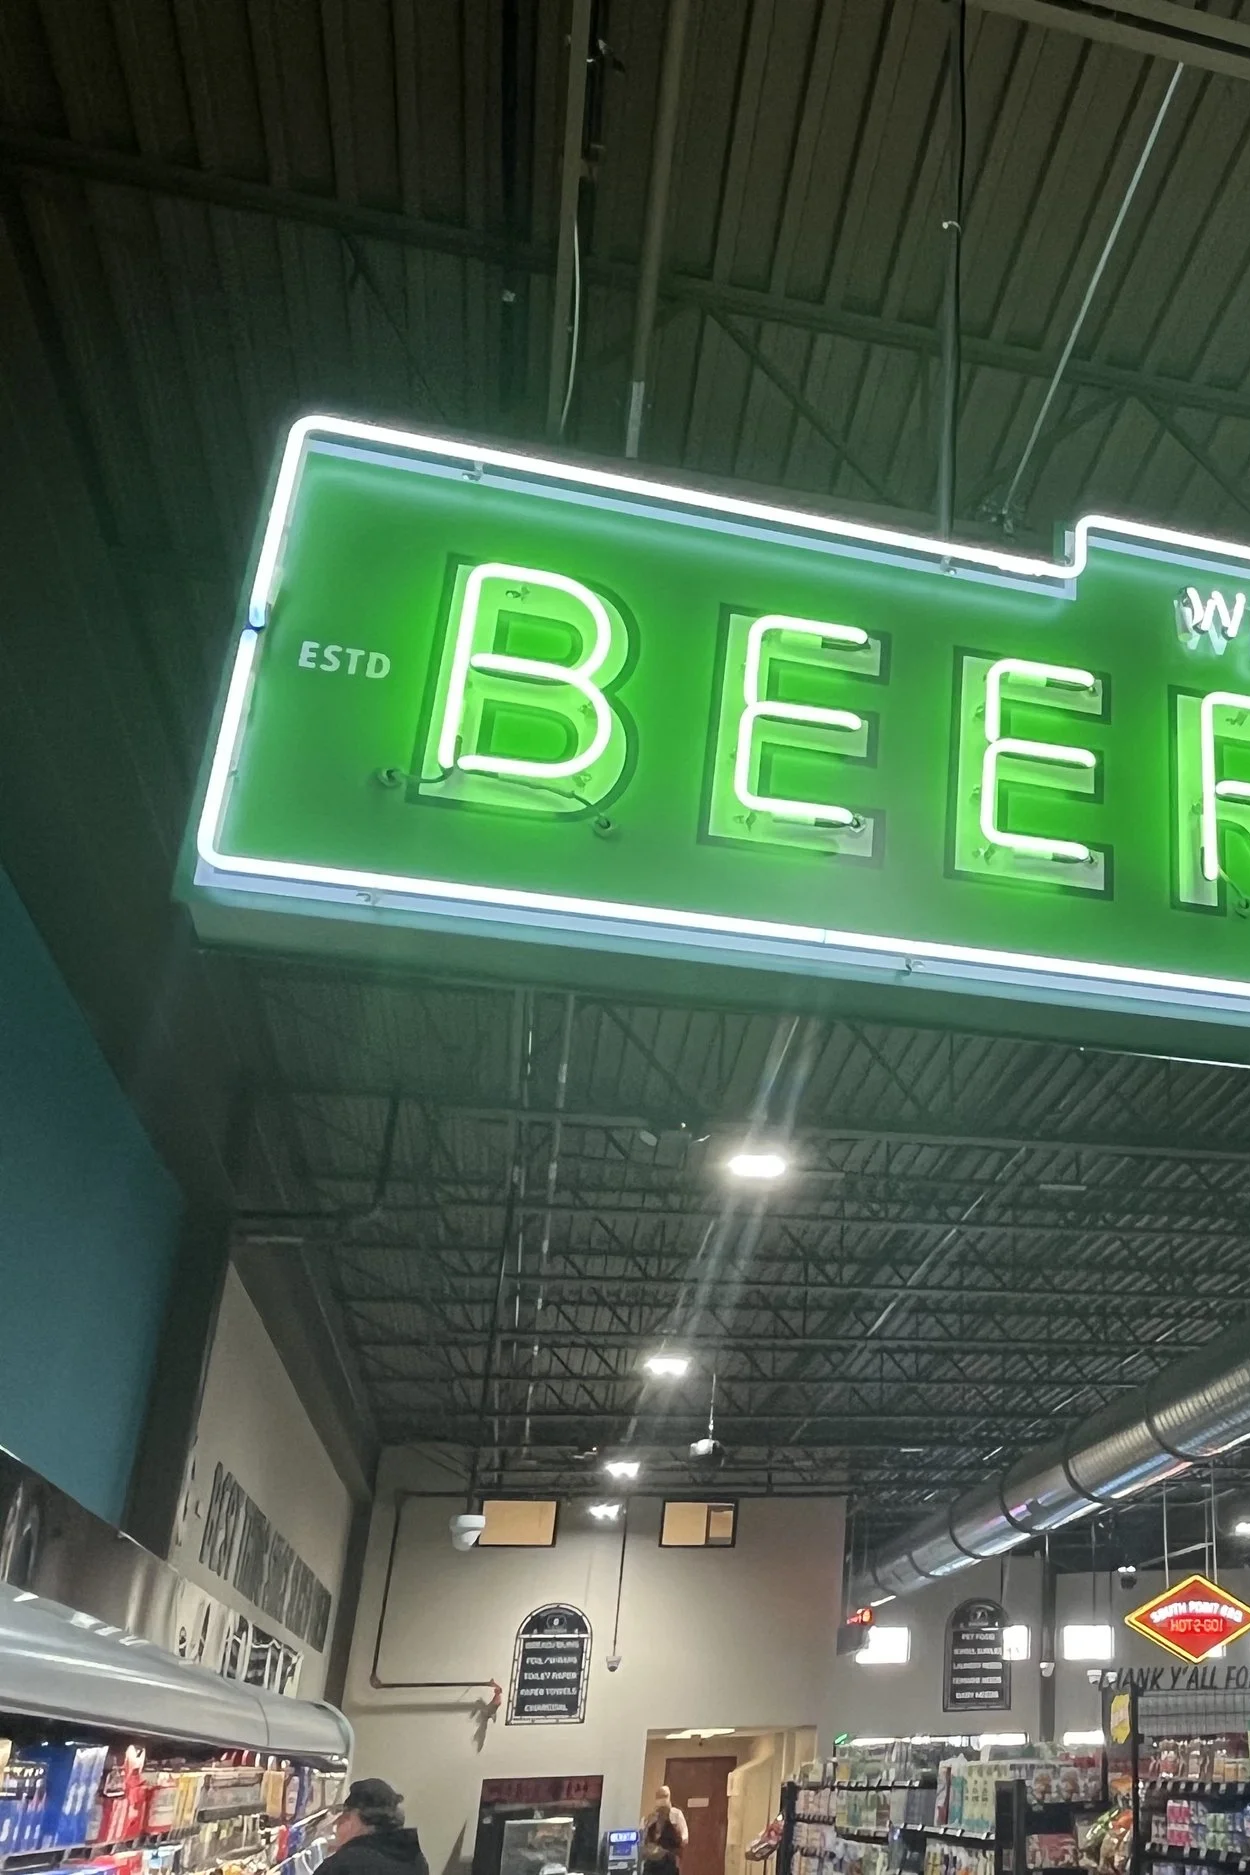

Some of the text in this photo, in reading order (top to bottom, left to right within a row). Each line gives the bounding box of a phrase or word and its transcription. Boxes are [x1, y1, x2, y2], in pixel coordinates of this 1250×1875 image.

[298, 640, 391, 679] ESTD
[1149, 1602, 1187, 1624] SOUTH
[1170, 1666, 1218, 1690] Y'ALL
